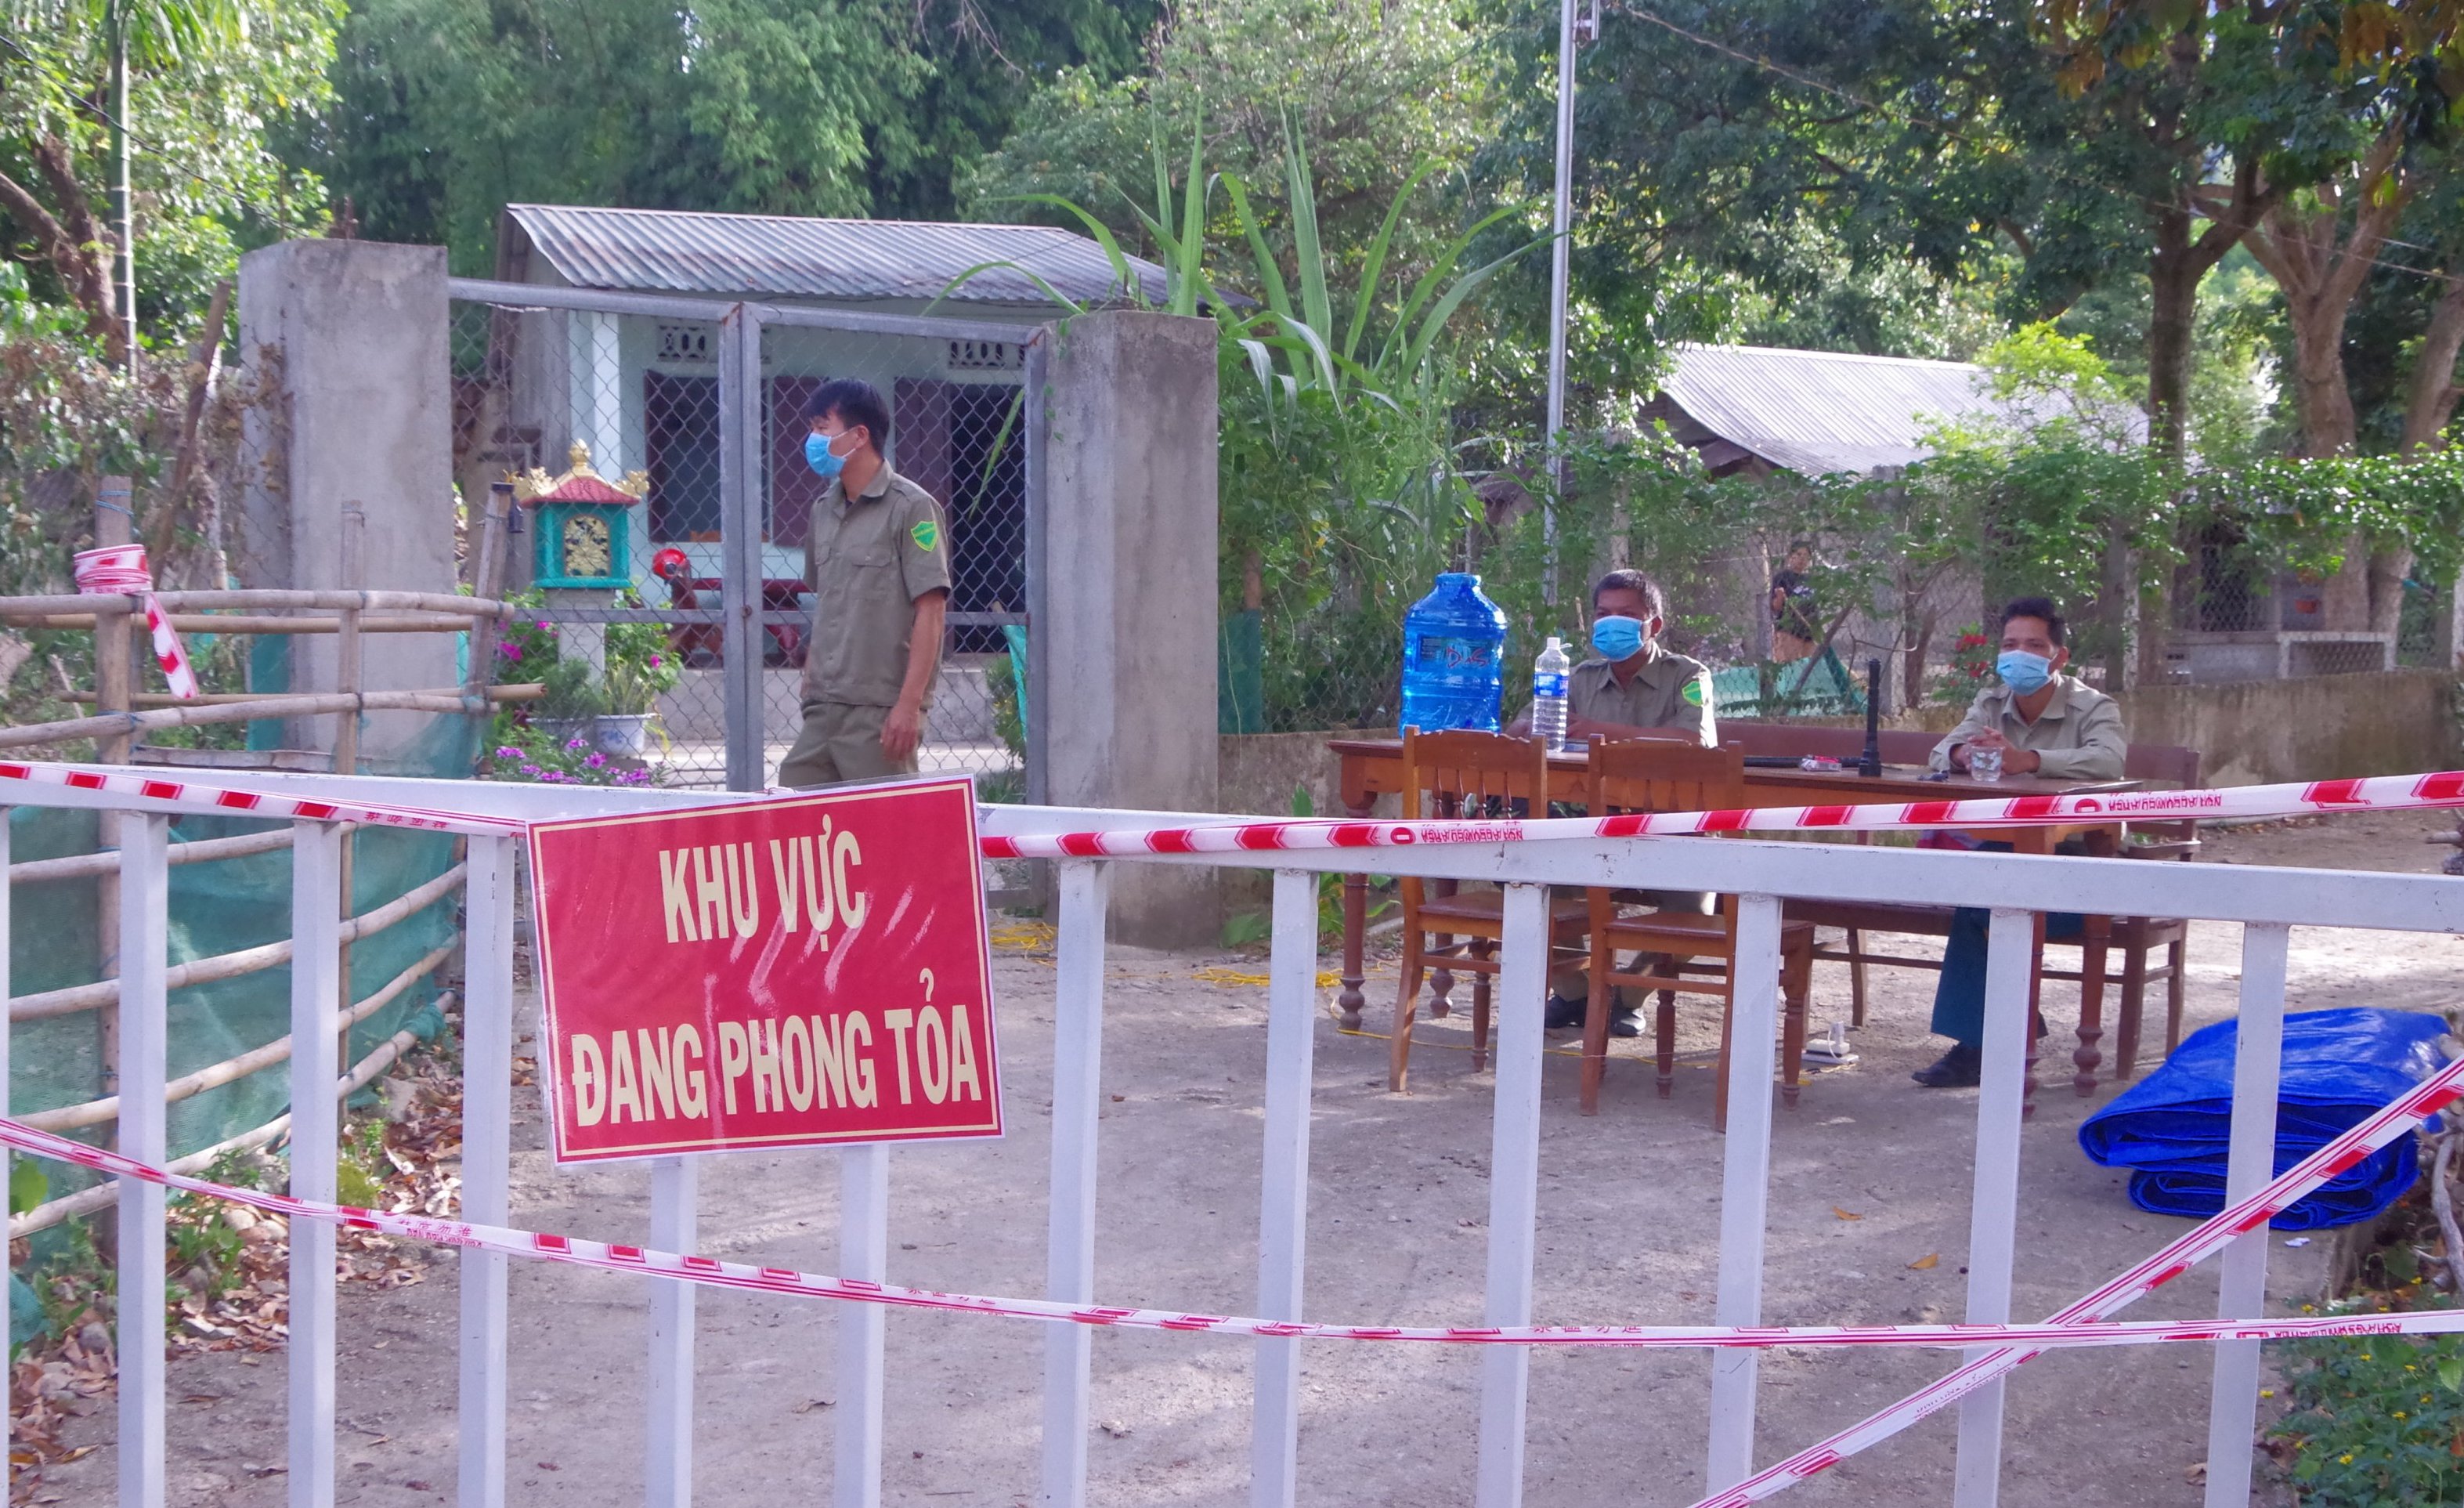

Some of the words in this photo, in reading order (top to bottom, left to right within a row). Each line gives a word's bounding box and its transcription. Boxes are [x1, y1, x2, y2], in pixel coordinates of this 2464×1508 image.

[659, 842, 759, 943] KHU
[769, 814, 866, 952] VỰC
[572, 1022, 708, 1127] ĐANG
[718, 1011, 878, 1116] PHONG
[885, 967, 981, 1105] TỎA
